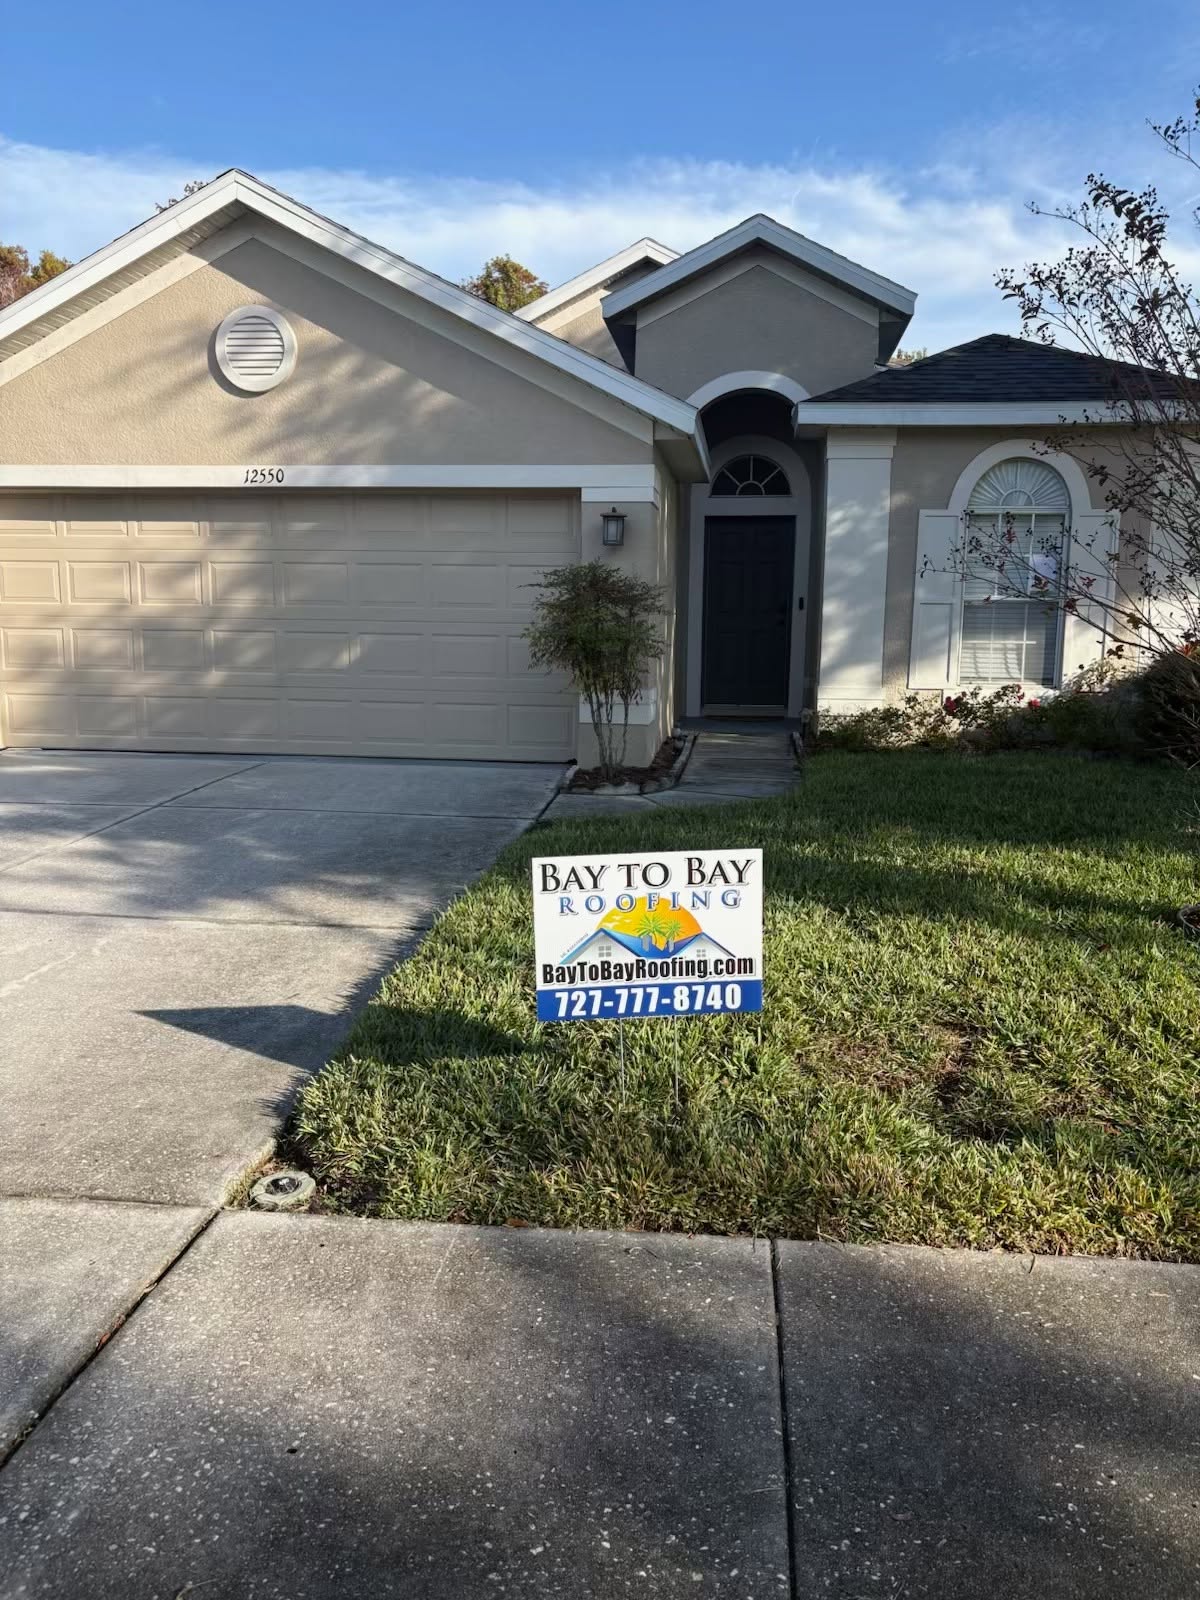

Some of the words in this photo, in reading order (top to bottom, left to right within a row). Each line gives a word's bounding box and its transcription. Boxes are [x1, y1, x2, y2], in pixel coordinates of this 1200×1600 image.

[244, 468, 284, 484] 12550
[540, 863, 608, 893] BAY
[618, 862, 671, 888] TO
[686, 857, 755, 886] BAY
[559, 890, 742, 916] ROOFING
[542, 957, 754, 984] BayToBayRoofing.com
[555, 984, 742, 1017] 727-777-8740
